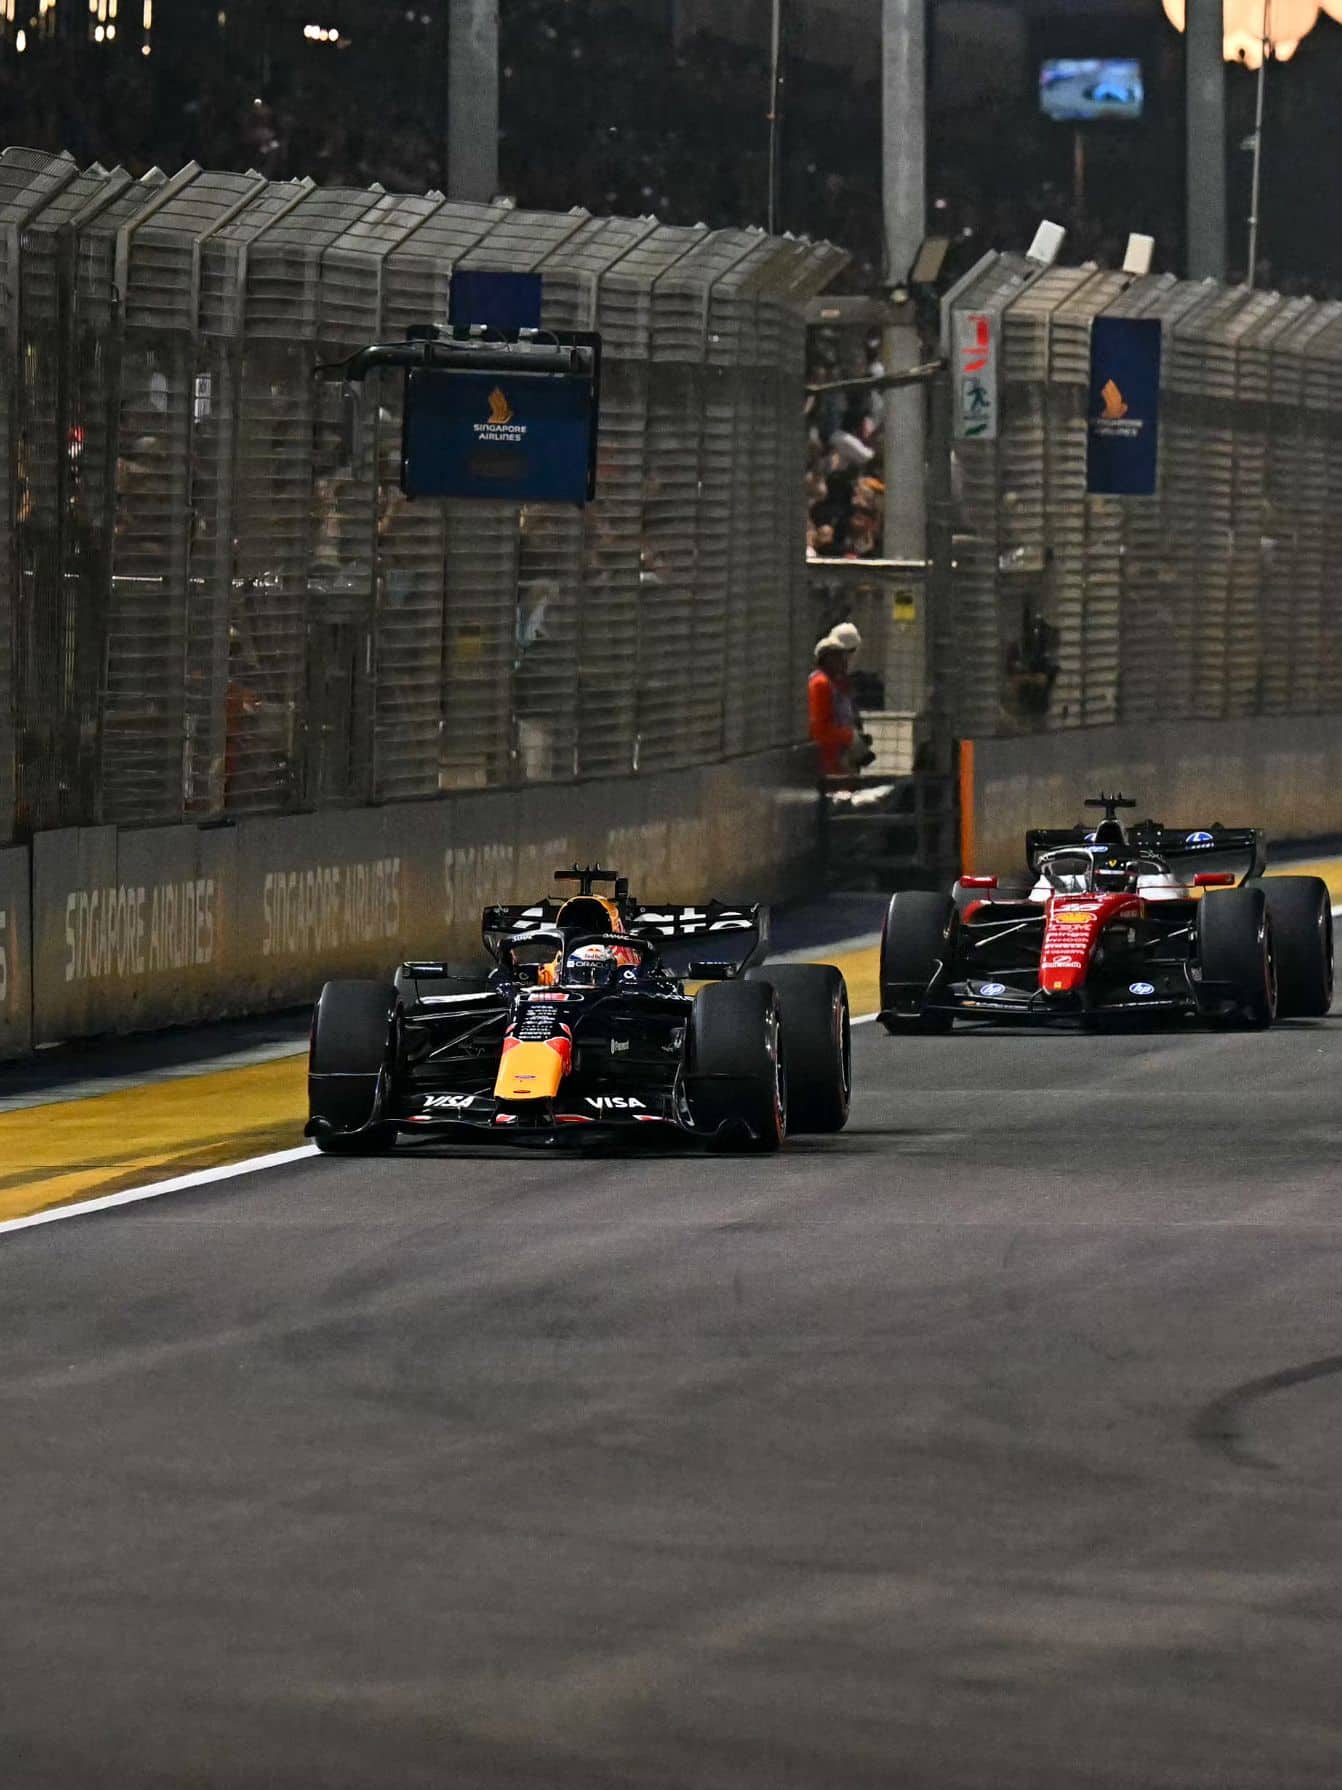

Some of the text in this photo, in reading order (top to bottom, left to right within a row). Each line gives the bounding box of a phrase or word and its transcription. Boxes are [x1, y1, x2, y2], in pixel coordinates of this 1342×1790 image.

[473, 424, 527, 433] SINGAPORE
[478, 433, 521, 441] AIRLINES
[65, 884, 145, 982] SINGAPORE
[150, 879, 214, 972] AIRLINES
[424, 1096, 475, 1107] VISA
[585, 1097, 647, 1108] VISA
